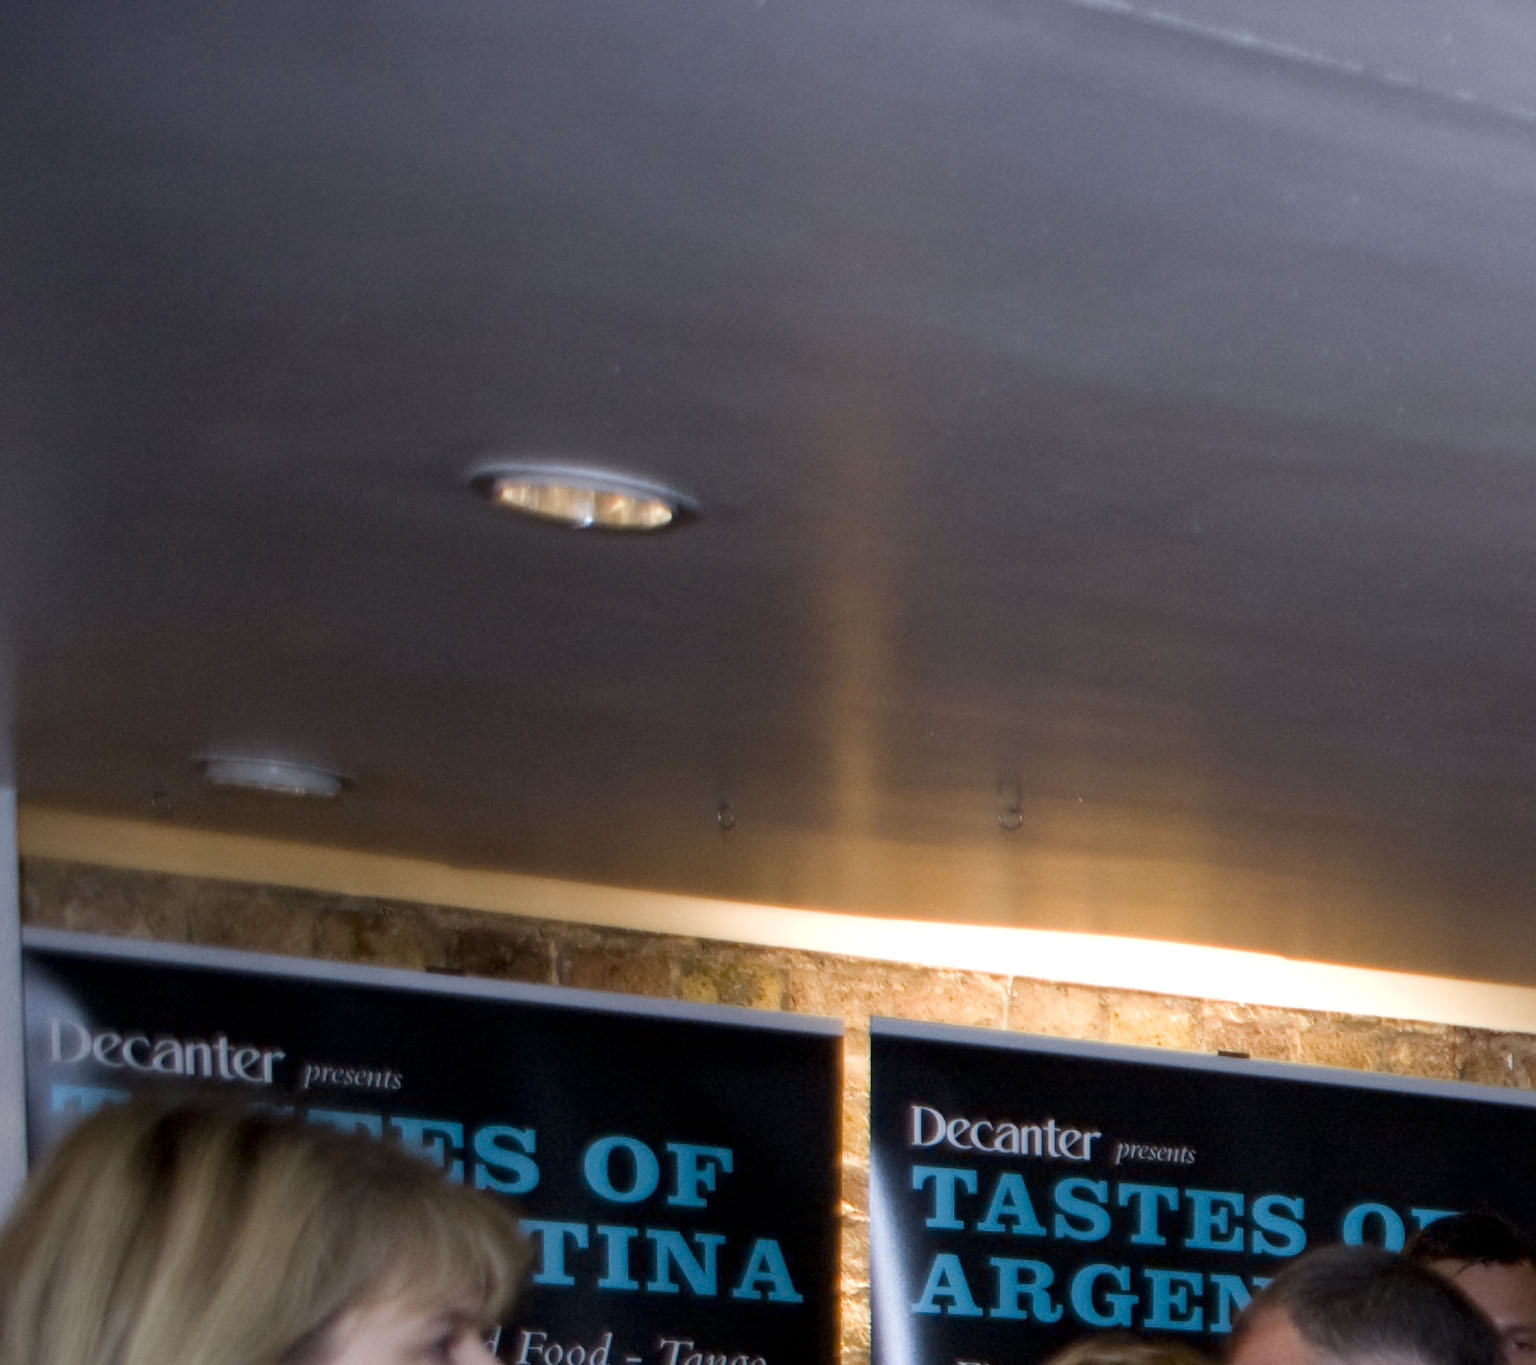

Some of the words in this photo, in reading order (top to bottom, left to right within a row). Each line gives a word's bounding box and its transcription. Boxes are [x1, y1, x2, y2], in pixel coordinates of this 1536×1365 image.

[49, 1016, 286, 1084] Decanter
[303, 1063, 403, 1090] presents
[583, 1135, 735, 1209] OF
[909, 1104, 1102, 1162] Decanter
[1114, 1140, 1198, 1166] presents
[911, 1165, 1308, 1258] TASTES
[1341, 1203, 1465, 1256] O
[909, 1253, 1275, 1335] ARGEN
